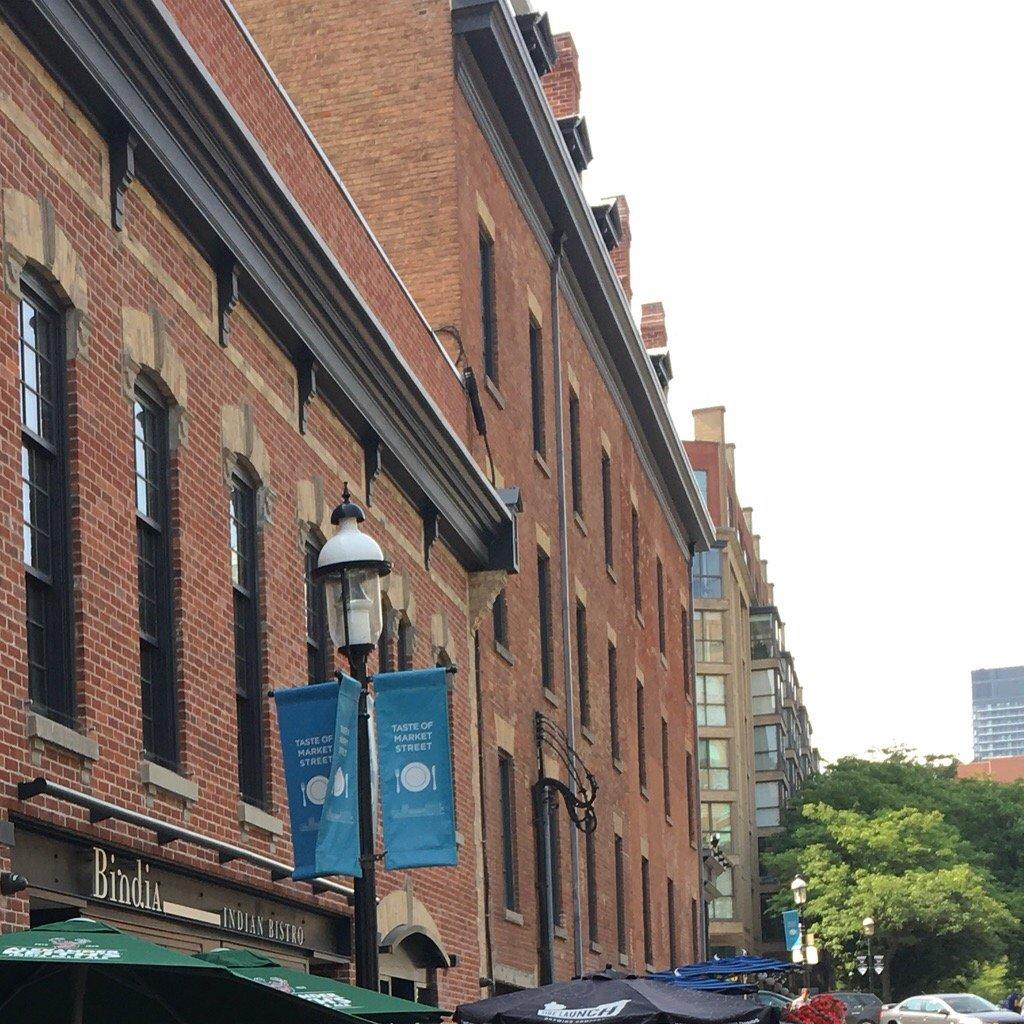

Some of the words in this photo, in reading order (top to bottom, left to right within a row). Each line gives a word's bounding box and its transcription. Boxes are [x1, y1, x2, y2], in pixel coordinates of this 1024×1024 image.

[391, 722, 420, 733] TASTE
[420, 721, 434, 730] OF
[294, 736, 320, 747] TASTE
[393, 731, 433, 743] MARKET
[297, 745, 333, 757] MARKET
[395, 742, 432, 754] STREET
[299, 756, 333, 767] STREET
[222, 906, 264, 936] INDIAN
[268, 917, 305, 946] BISTRO
[558, 1005, 618, 1018] LAUNCH
